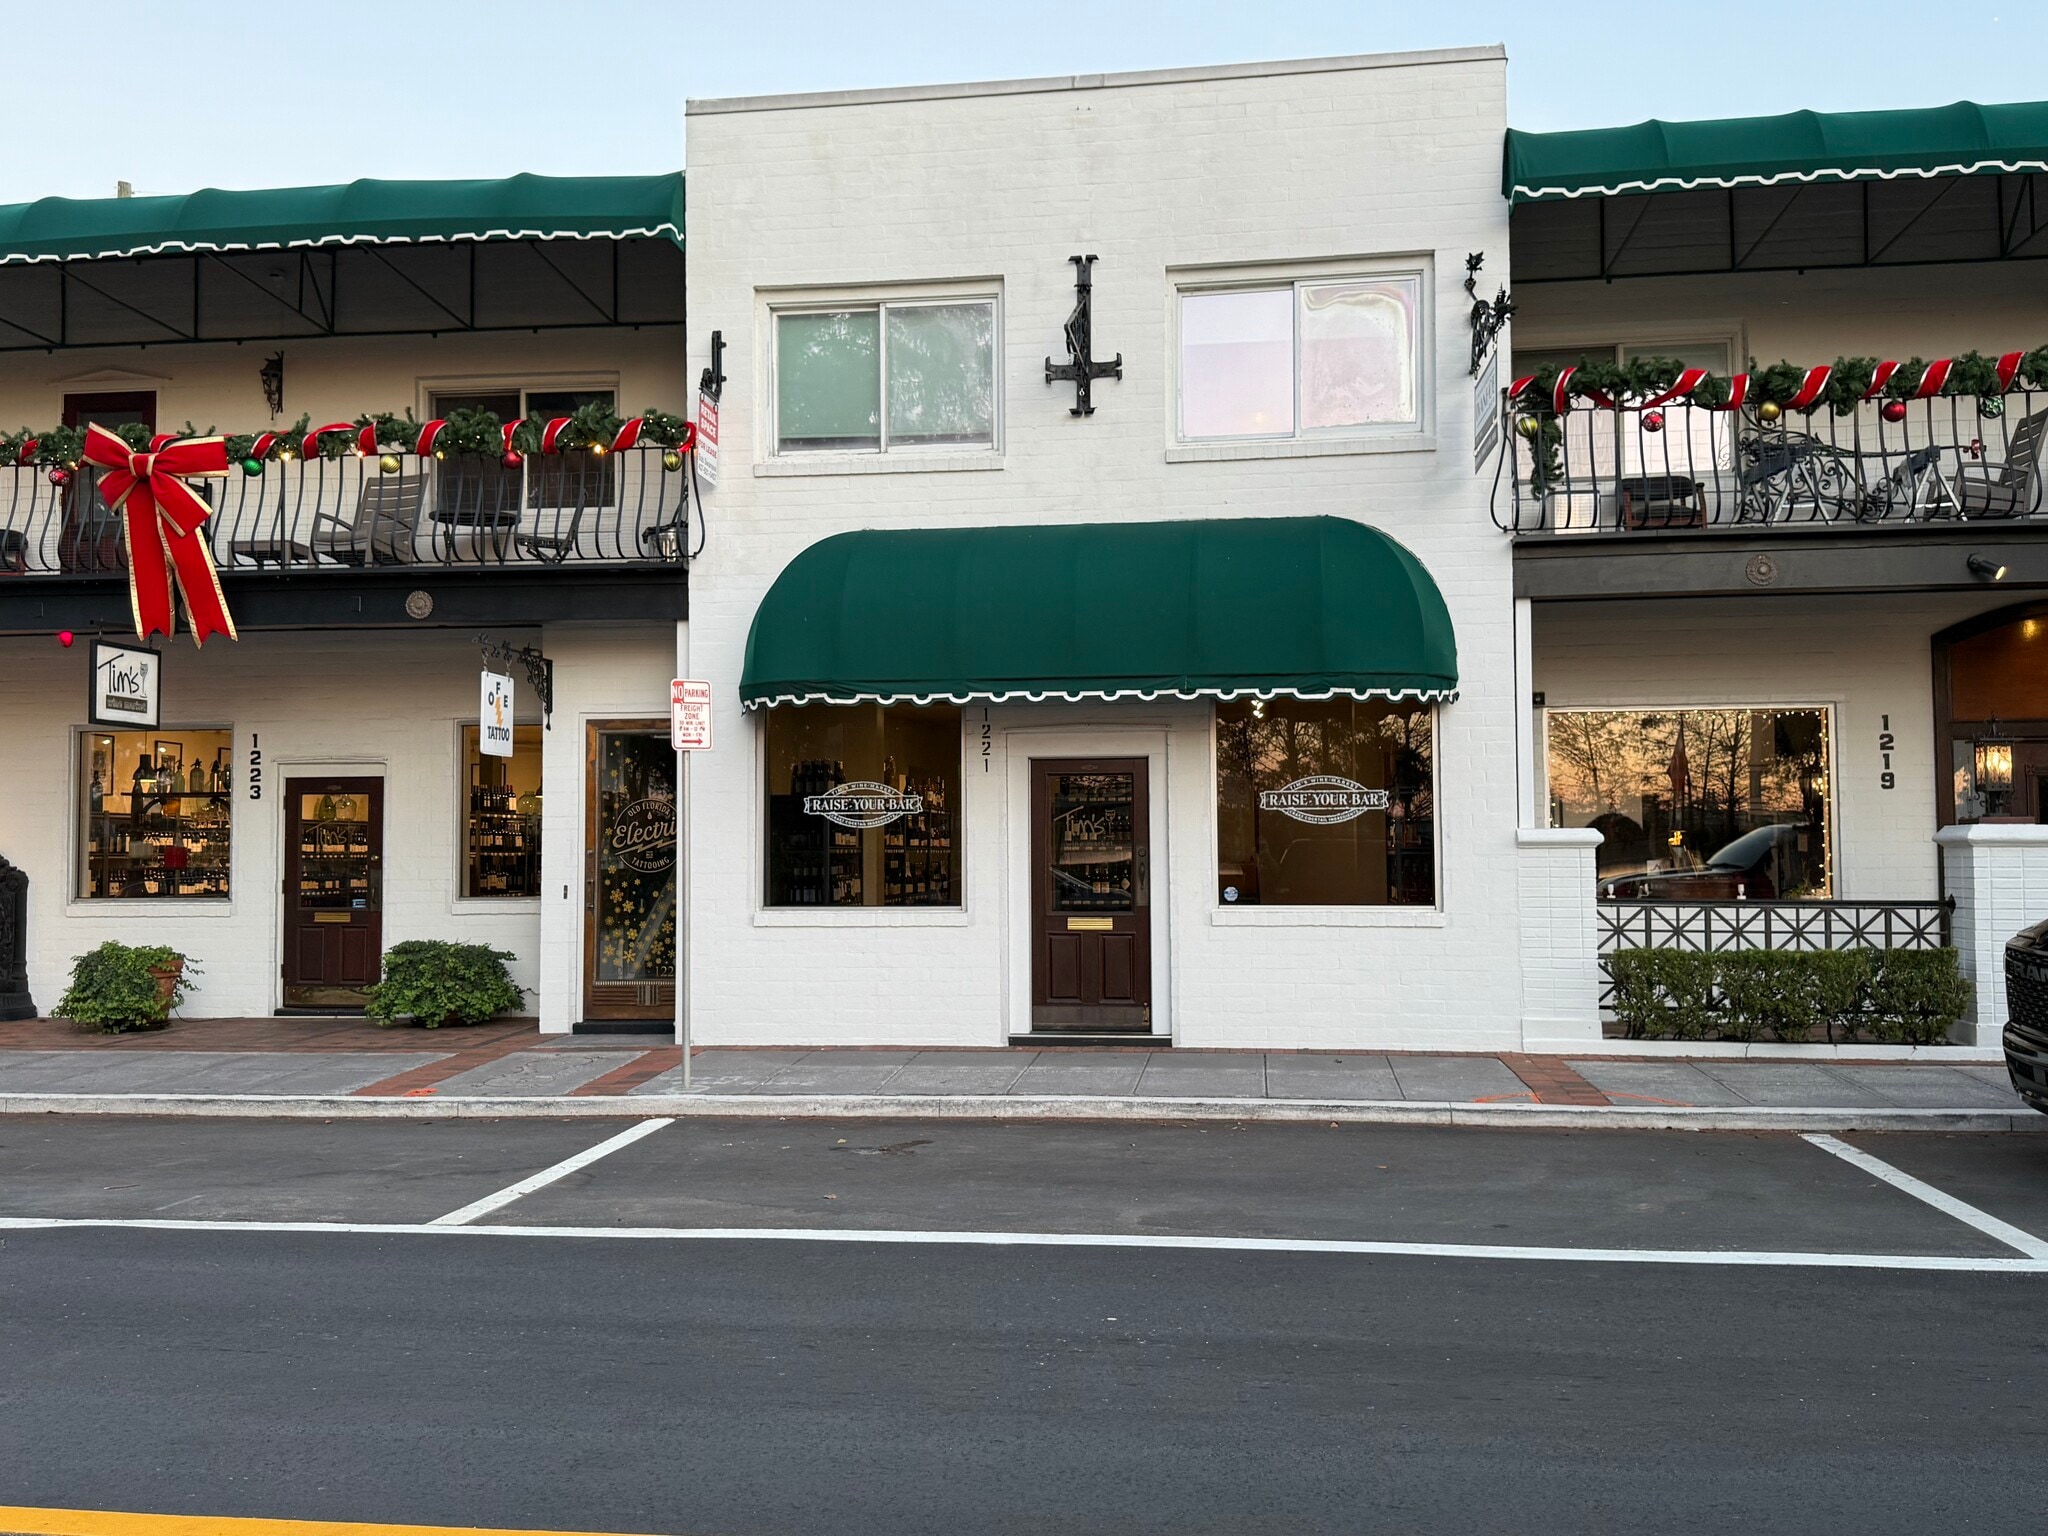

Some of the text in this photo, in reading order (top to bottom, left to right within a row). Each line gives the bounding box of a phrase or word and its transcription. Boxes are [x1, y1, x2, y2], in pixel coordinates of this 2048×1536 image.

[701, 418, 717, 439] SPACE
[98, 653, 140, 695] Tim's
[673, 685, 708, 699] NO PARKING
[684, 712, 699, 720] ZONE
[487, 726, 510, 741] TATTOO
[982, 707, 990, 773] 1221
[1879, 714, 1895, 790] 1219
[250, 733, 261, 800] 1223
[812, 799, 915, 811] RAISE YOUR BAR
[1269, 793, 1380, 806] RAISE YOUR BAR
[627, 805, 640, 817] OLD
[1053, 805, 1105, 837] Tim's
[305, 819, 348, 845] Tim's
[612, 815, 677, 848] Electri
[631, 856, 670, 869] TATTOOING
